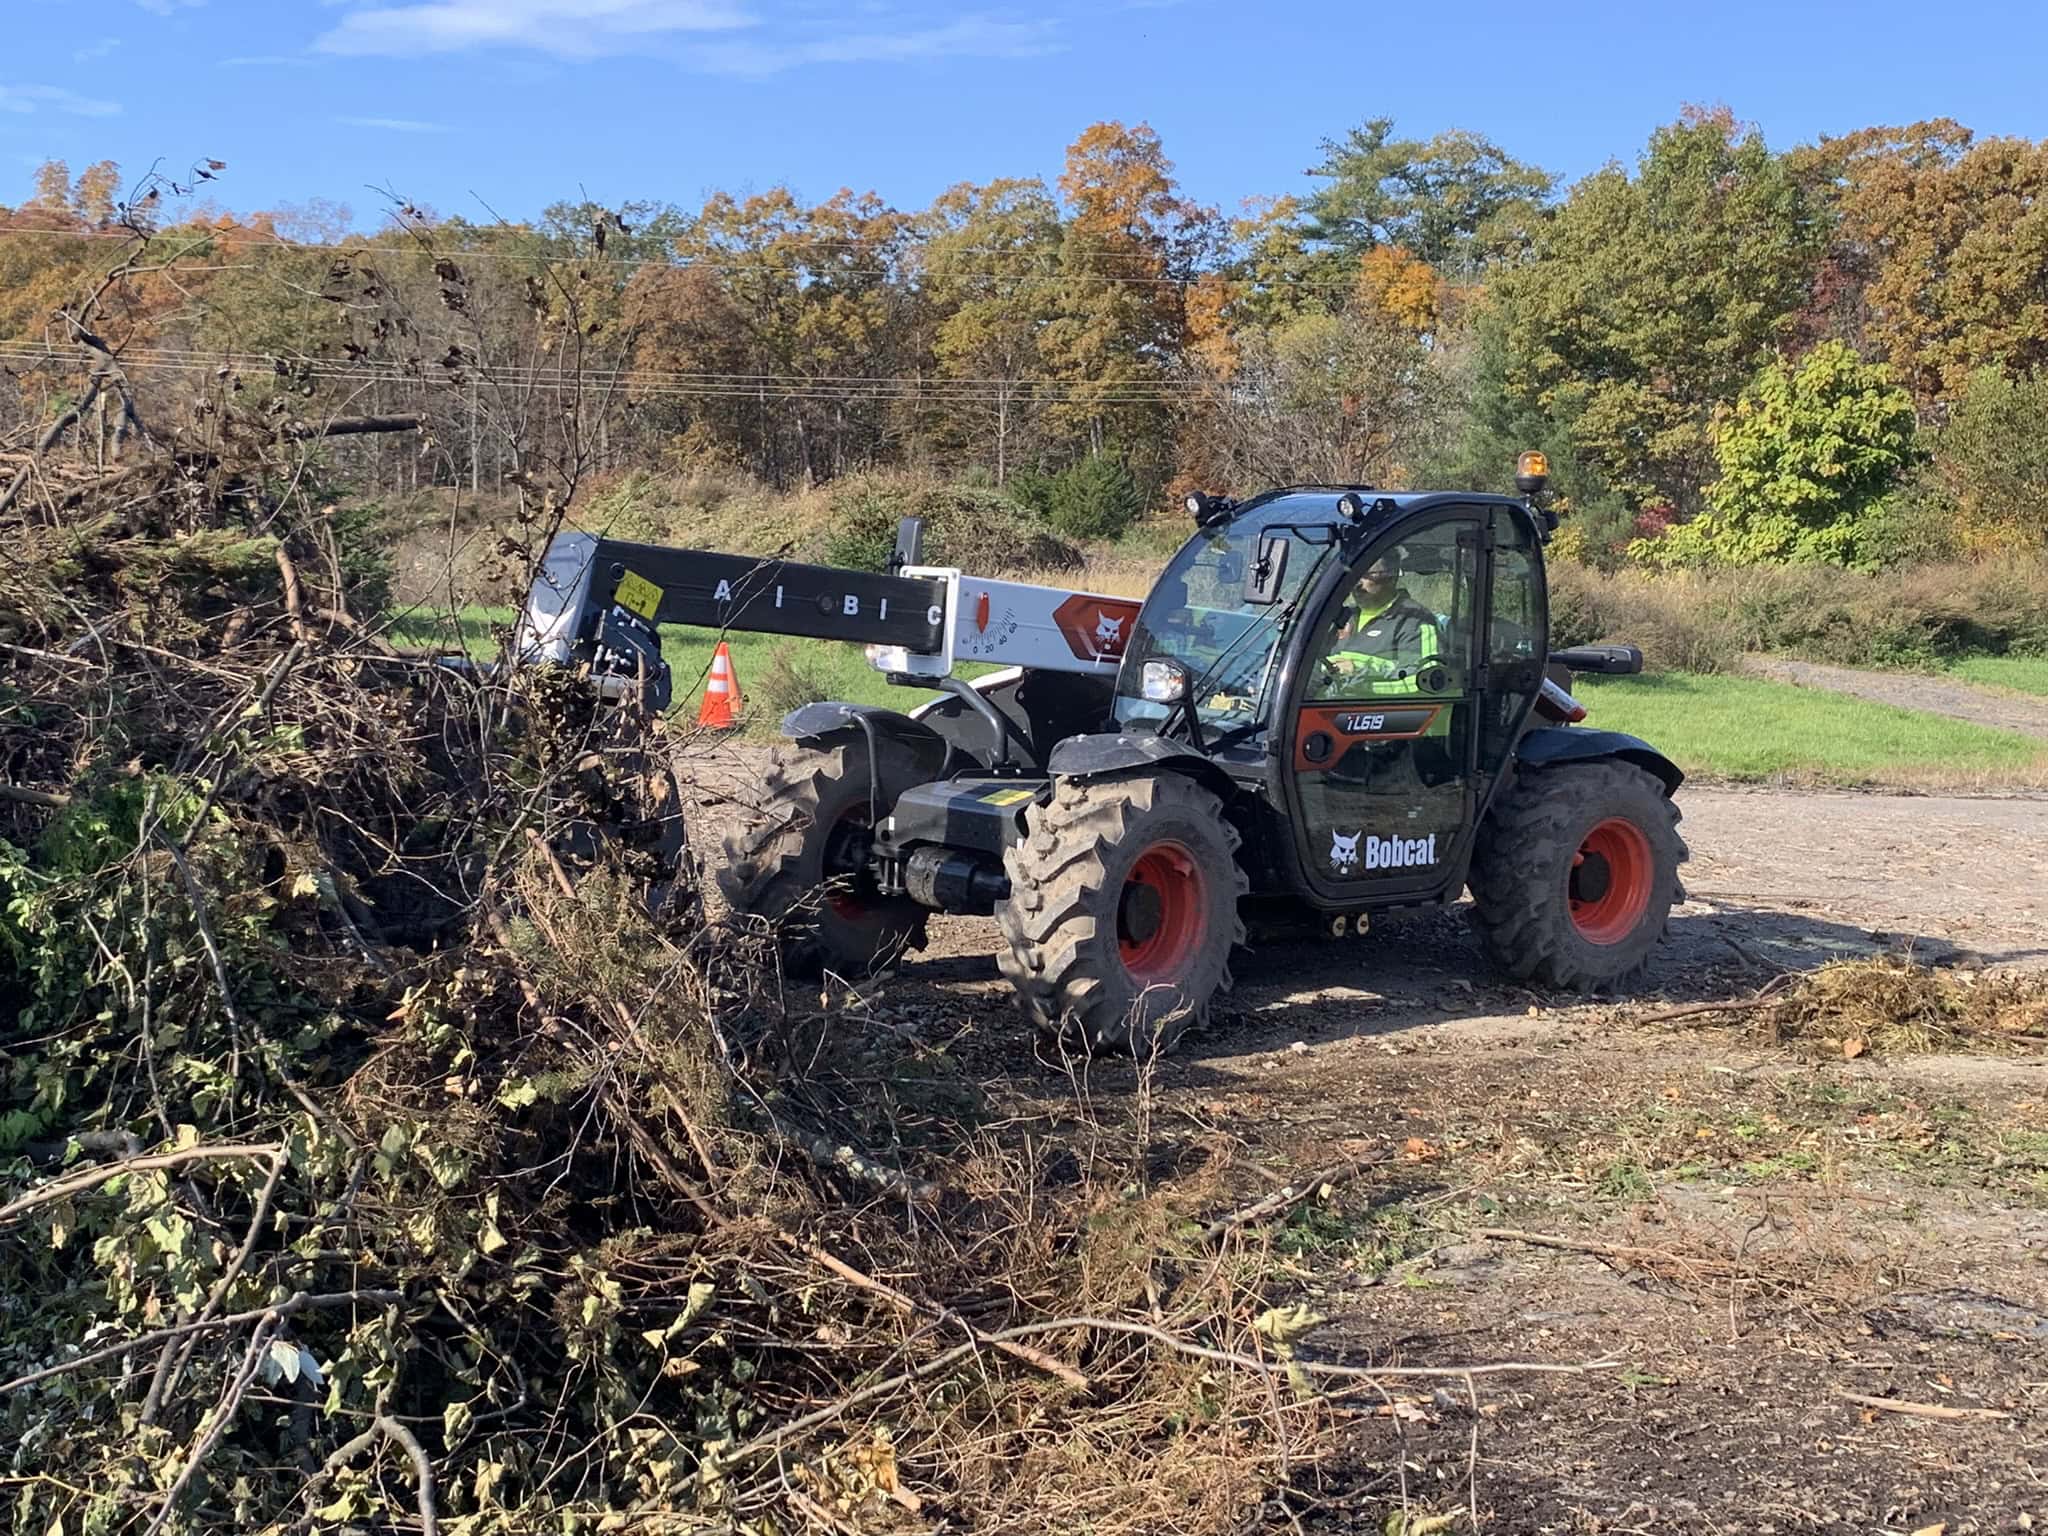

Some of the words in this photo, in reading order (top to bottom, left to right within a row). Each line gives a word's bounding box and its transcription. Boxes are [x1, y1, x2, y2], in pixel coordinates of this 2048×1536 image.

[713, 579, 732, 601] A
[843, 594, 859, 616] B
[927, 604, 943, 626] C
[972, 645, 978, 655] 0
[984, 643, 994, 654] 20
[1365, 832, 1436, 869] Bobcat
